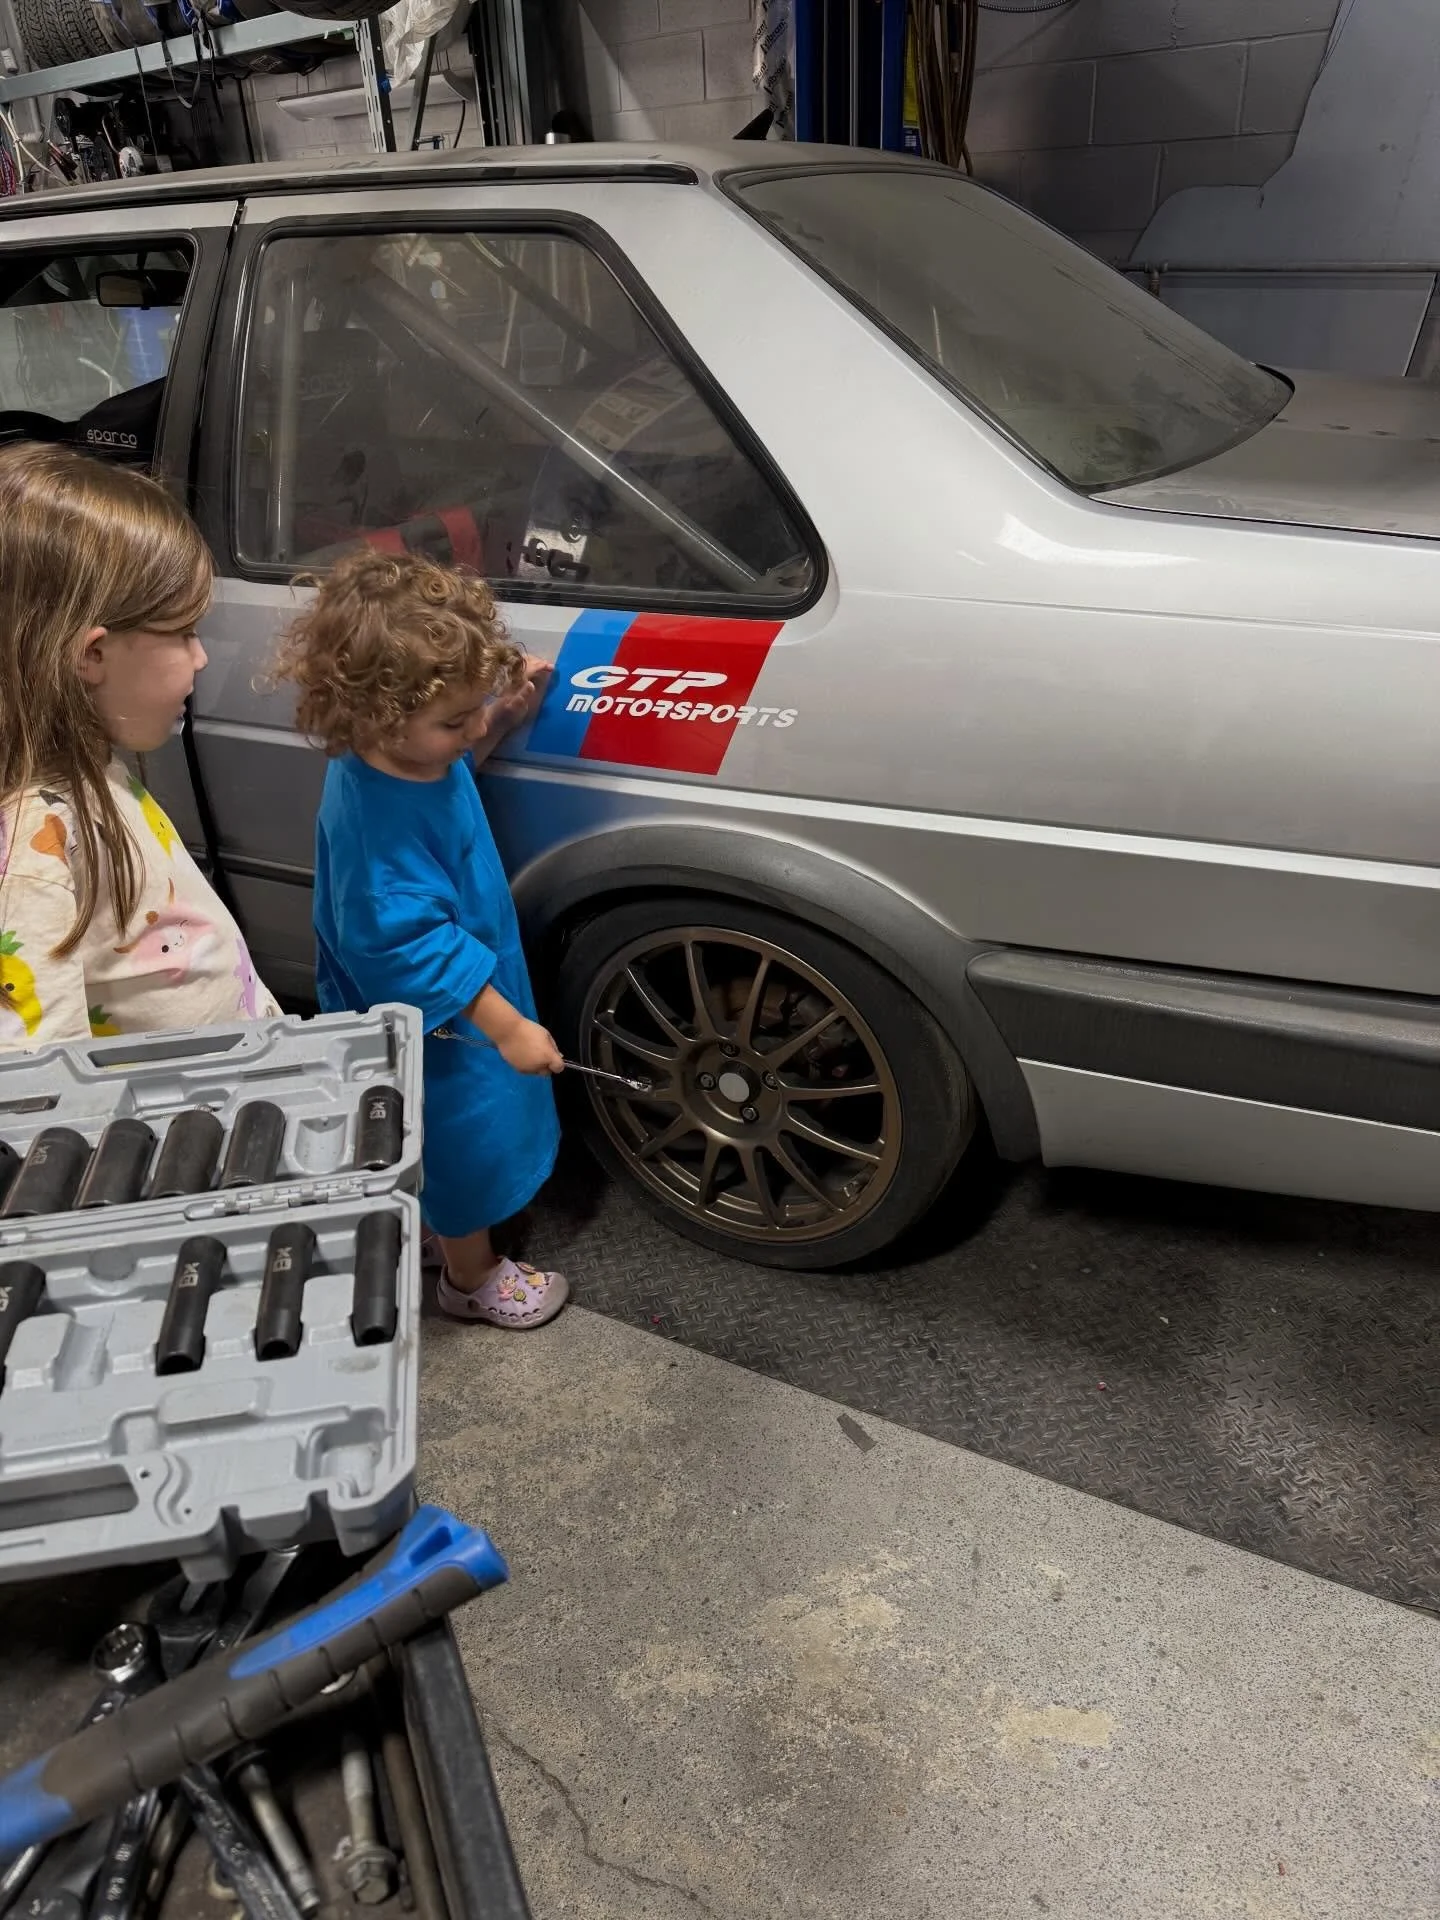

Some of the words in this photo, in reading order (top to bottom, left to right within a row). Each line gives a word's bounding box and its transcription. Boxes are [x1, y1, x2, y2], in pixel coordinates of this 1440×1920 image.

[86, 428, 137, 447] sparco
[570, 665, 728, 695] GTP
[565, 693, 798, 728] MOTORSPORTS
